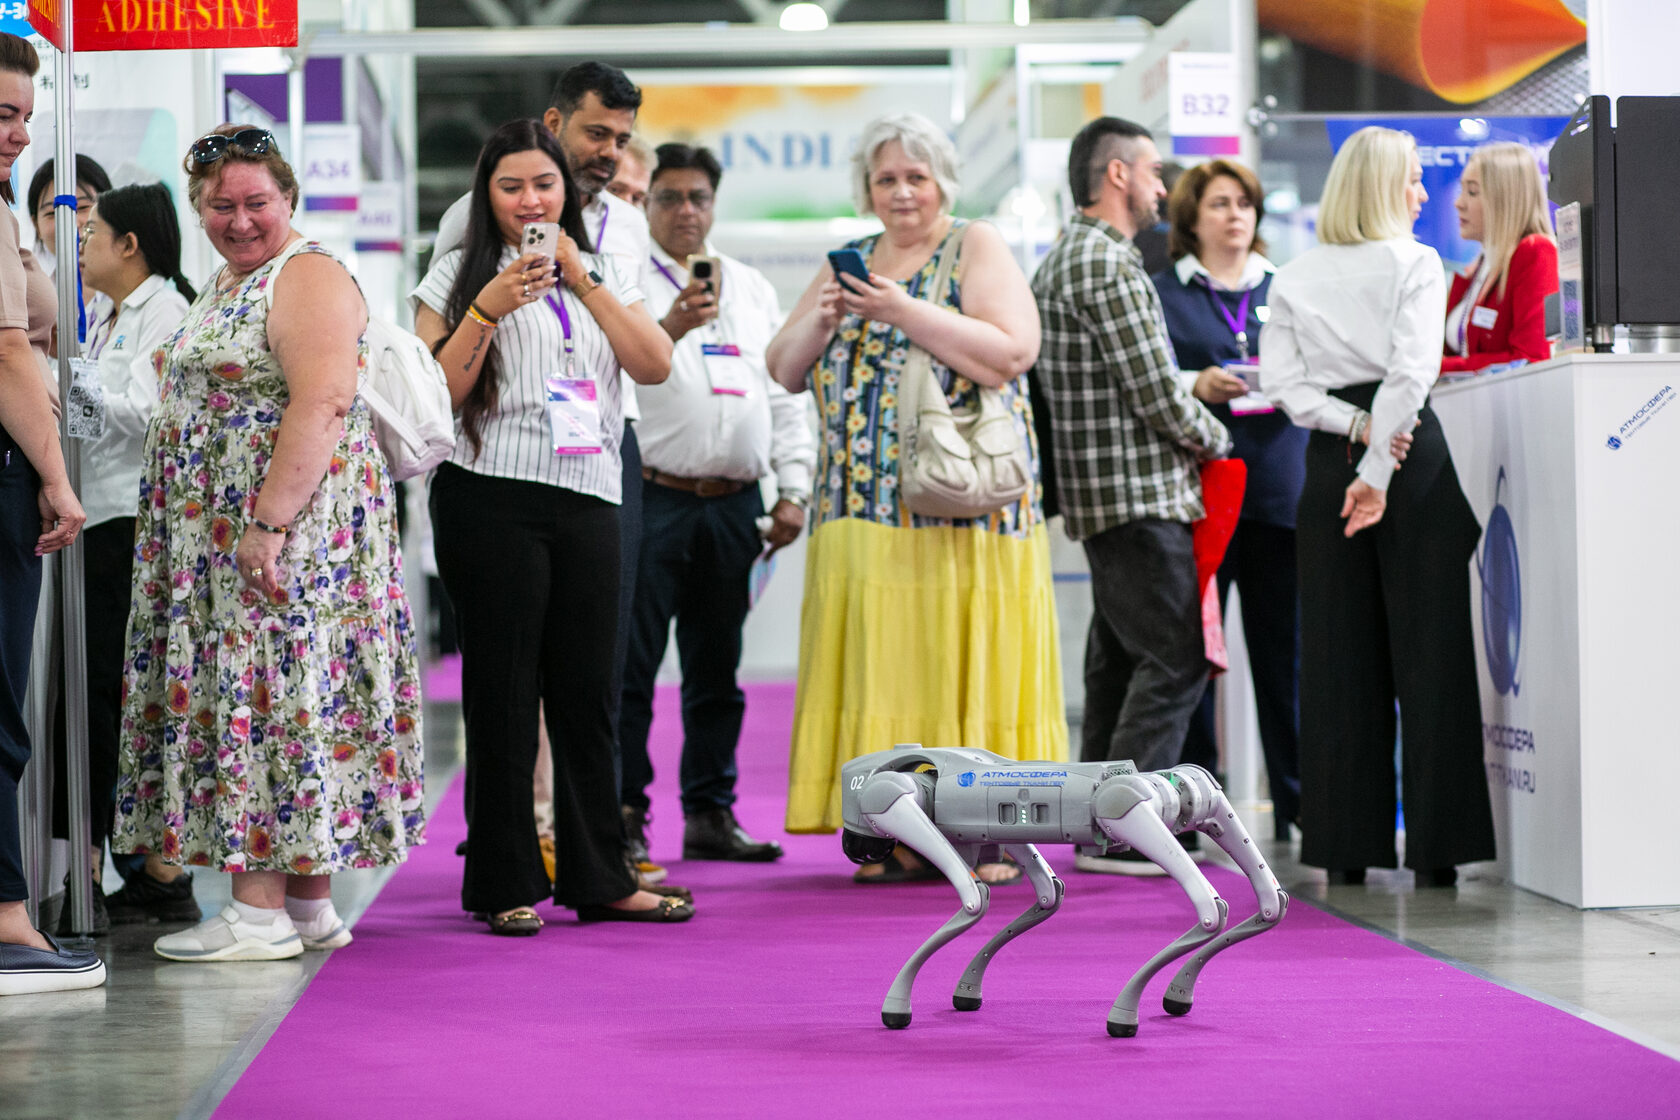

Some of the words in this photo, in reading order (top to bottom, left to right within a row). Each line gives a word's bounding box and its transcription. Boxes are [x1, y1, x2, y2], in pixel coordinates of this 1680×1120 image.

[95, 0, 275, 33] ADHESIVE
[1181, 93, 1231, 117] B32
[721, 131, 853, 169] INDI
[1619, 385, 1672, 434] АТМОСФЕРА
[850, 776, 865, 790] 02
